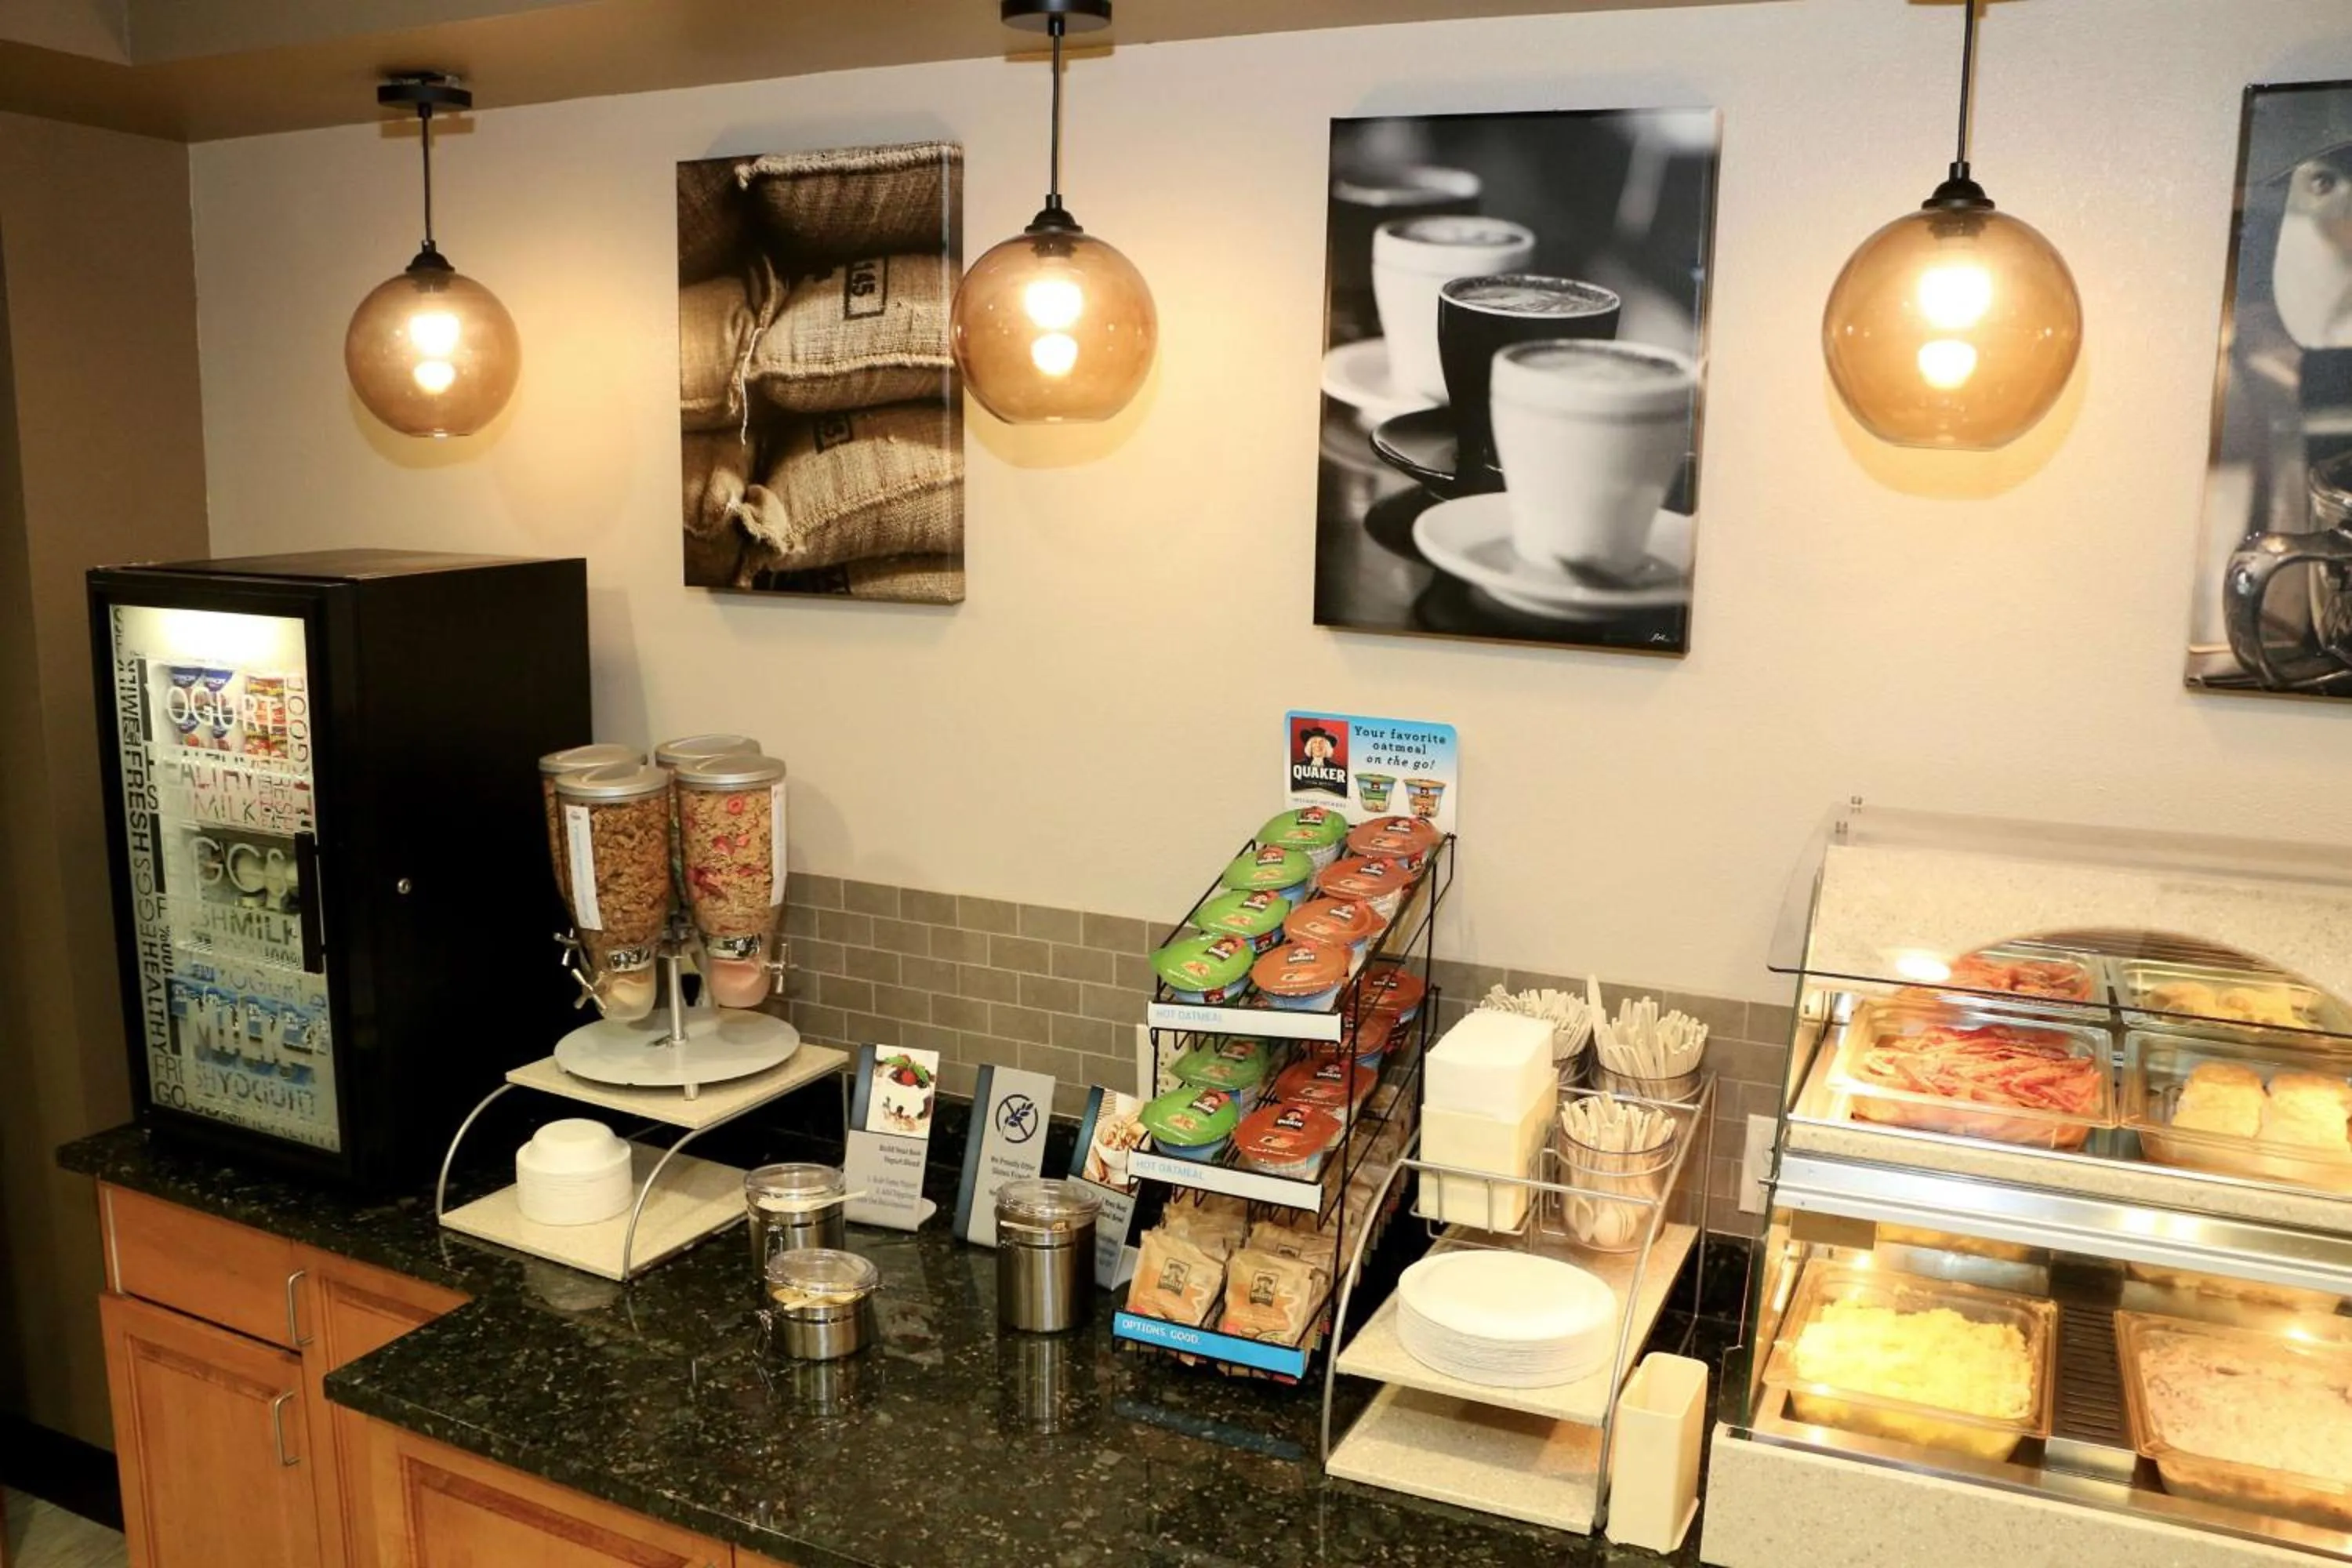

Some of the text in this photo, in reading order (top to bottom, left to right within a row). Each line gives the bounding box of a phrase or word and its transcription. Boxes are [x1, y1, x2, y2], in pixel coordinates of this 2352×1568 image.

[1354, 725, 1446, 744] Your favorite
[1373, 742, 1426, 755] oatmeal
[1367, 755, 1436, 770] on the go!
[1293, 764, 1345, 783] QUAKER
[125, 750, 149, 852] FRESH
[134, 857, 157, 938] EGGS
[142, 940, 169, 1056] HEALTHY
